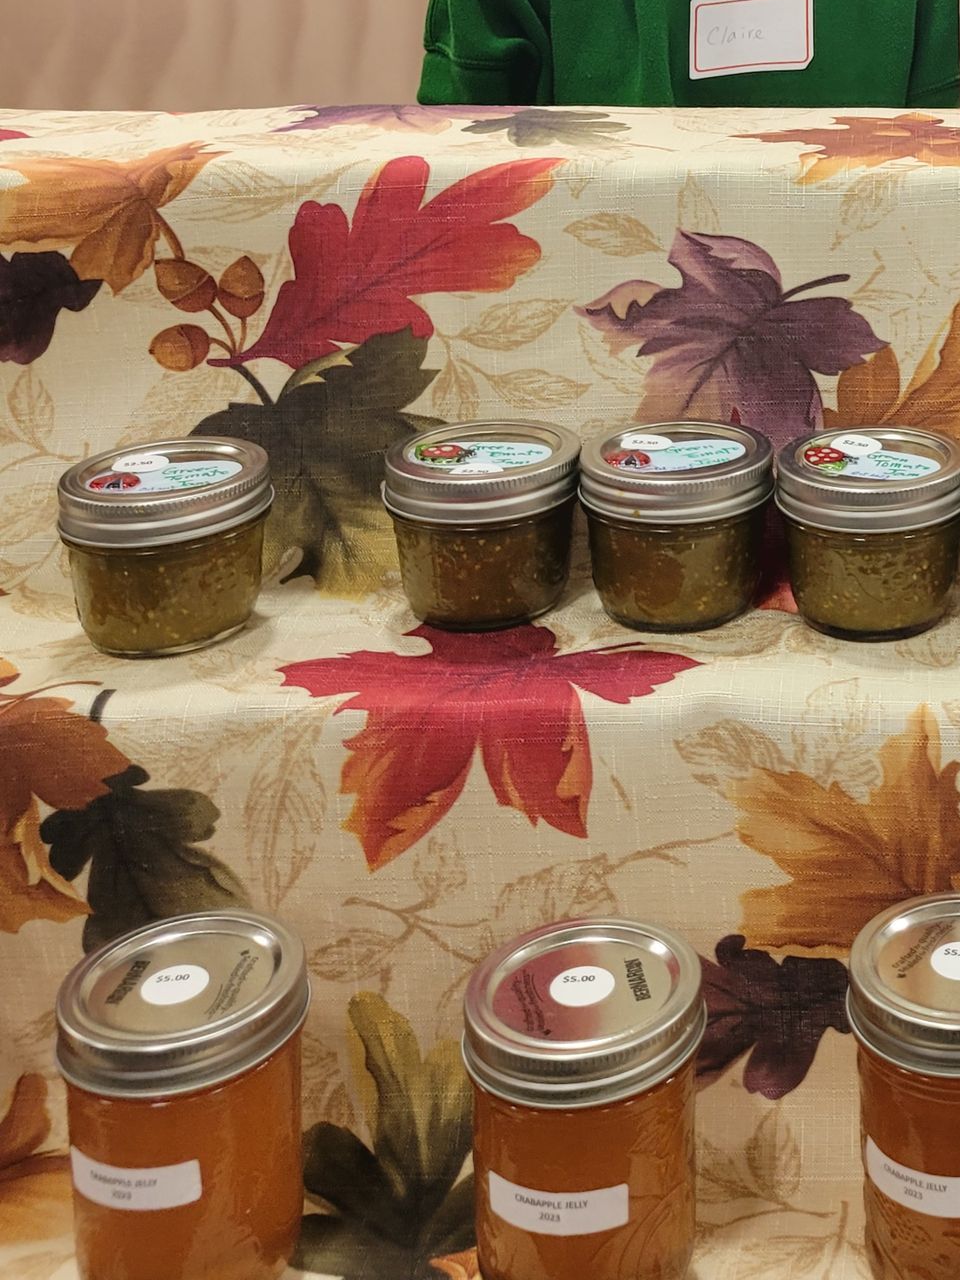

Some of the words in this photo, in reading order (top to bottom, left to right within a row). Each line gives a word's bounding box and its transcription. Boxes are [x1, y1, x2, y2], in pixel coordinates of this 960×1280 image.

[706, 26, 765, 46] Claire
[156, 973, 190, 983] $5.00
[563, 975, 596, 983] $5.00
[883, 1163, 924, 1188] CRABAPPLE
[926, 1183, 947, 1192] JELLY
[904, 1187, 923, 1200] 2023
[514, 1193, 562, 1209] CRABAPPLE
[565, 1200, 588, 1209] JELLY
[539, 1212, 560, 1222] 2023
